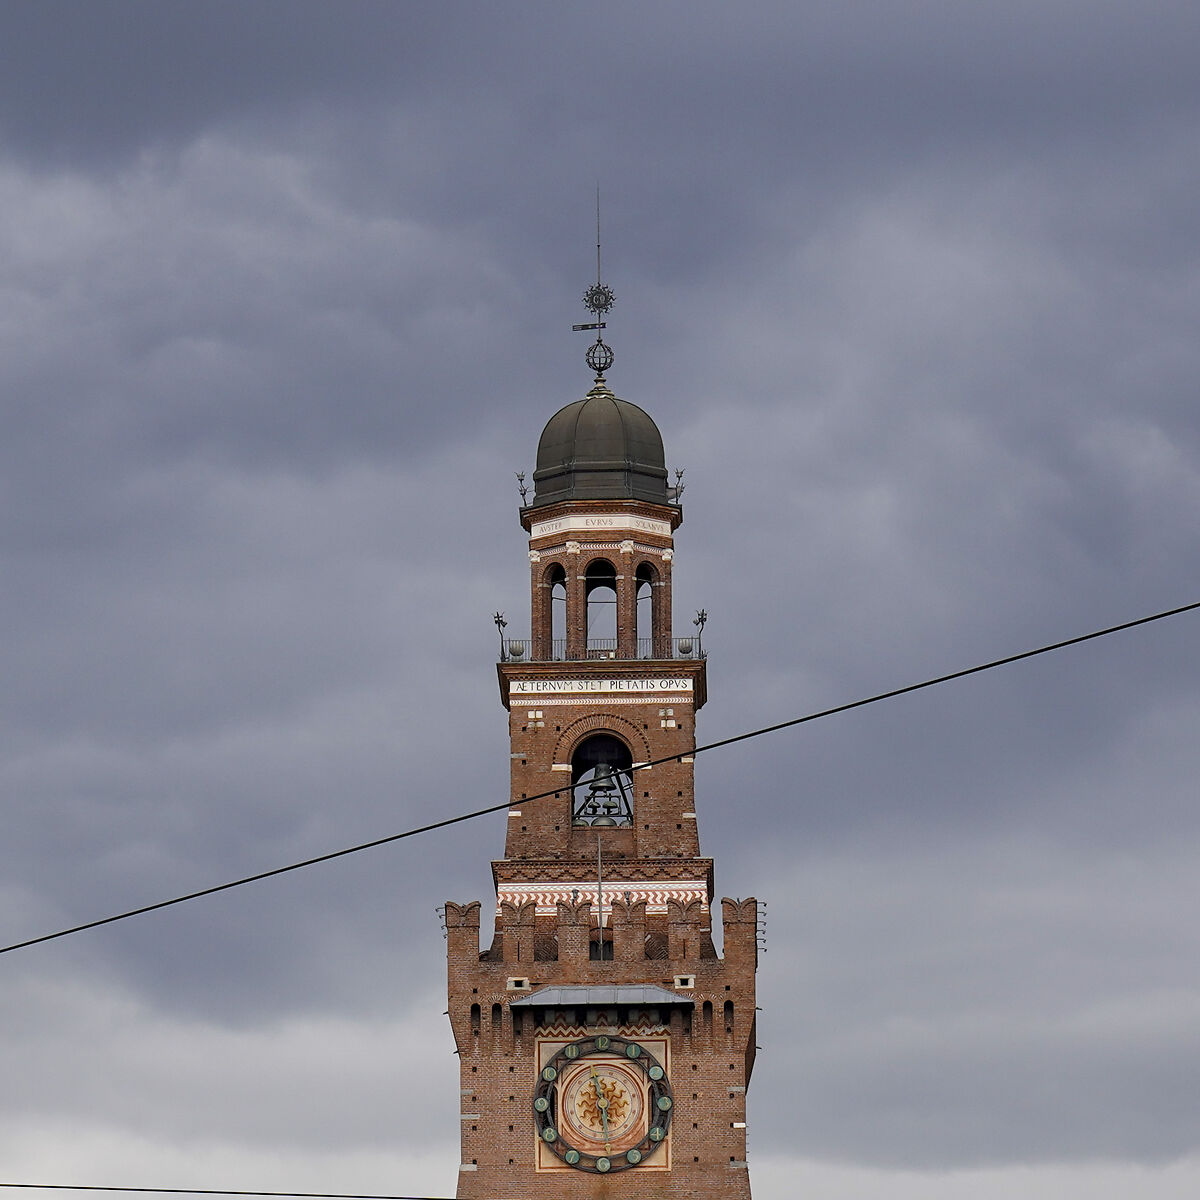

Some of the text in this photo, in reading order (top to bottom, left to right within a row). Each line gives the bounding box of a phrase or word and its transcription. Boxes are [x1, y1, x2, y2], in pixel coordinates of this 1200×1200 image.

[610, 680, 655, 690] PIETATIS
[660, 679, 688, 689] OPVS
[598, 1037, 608, 1048] 12
[568, 1046, 577, 1057] 11
[544, 1069, 555, 1079] 10
[538, 1099, 546, 1110] 9
[545, 1128, 555, 1141] 8
[650, 1128, 661, 1141] 4
